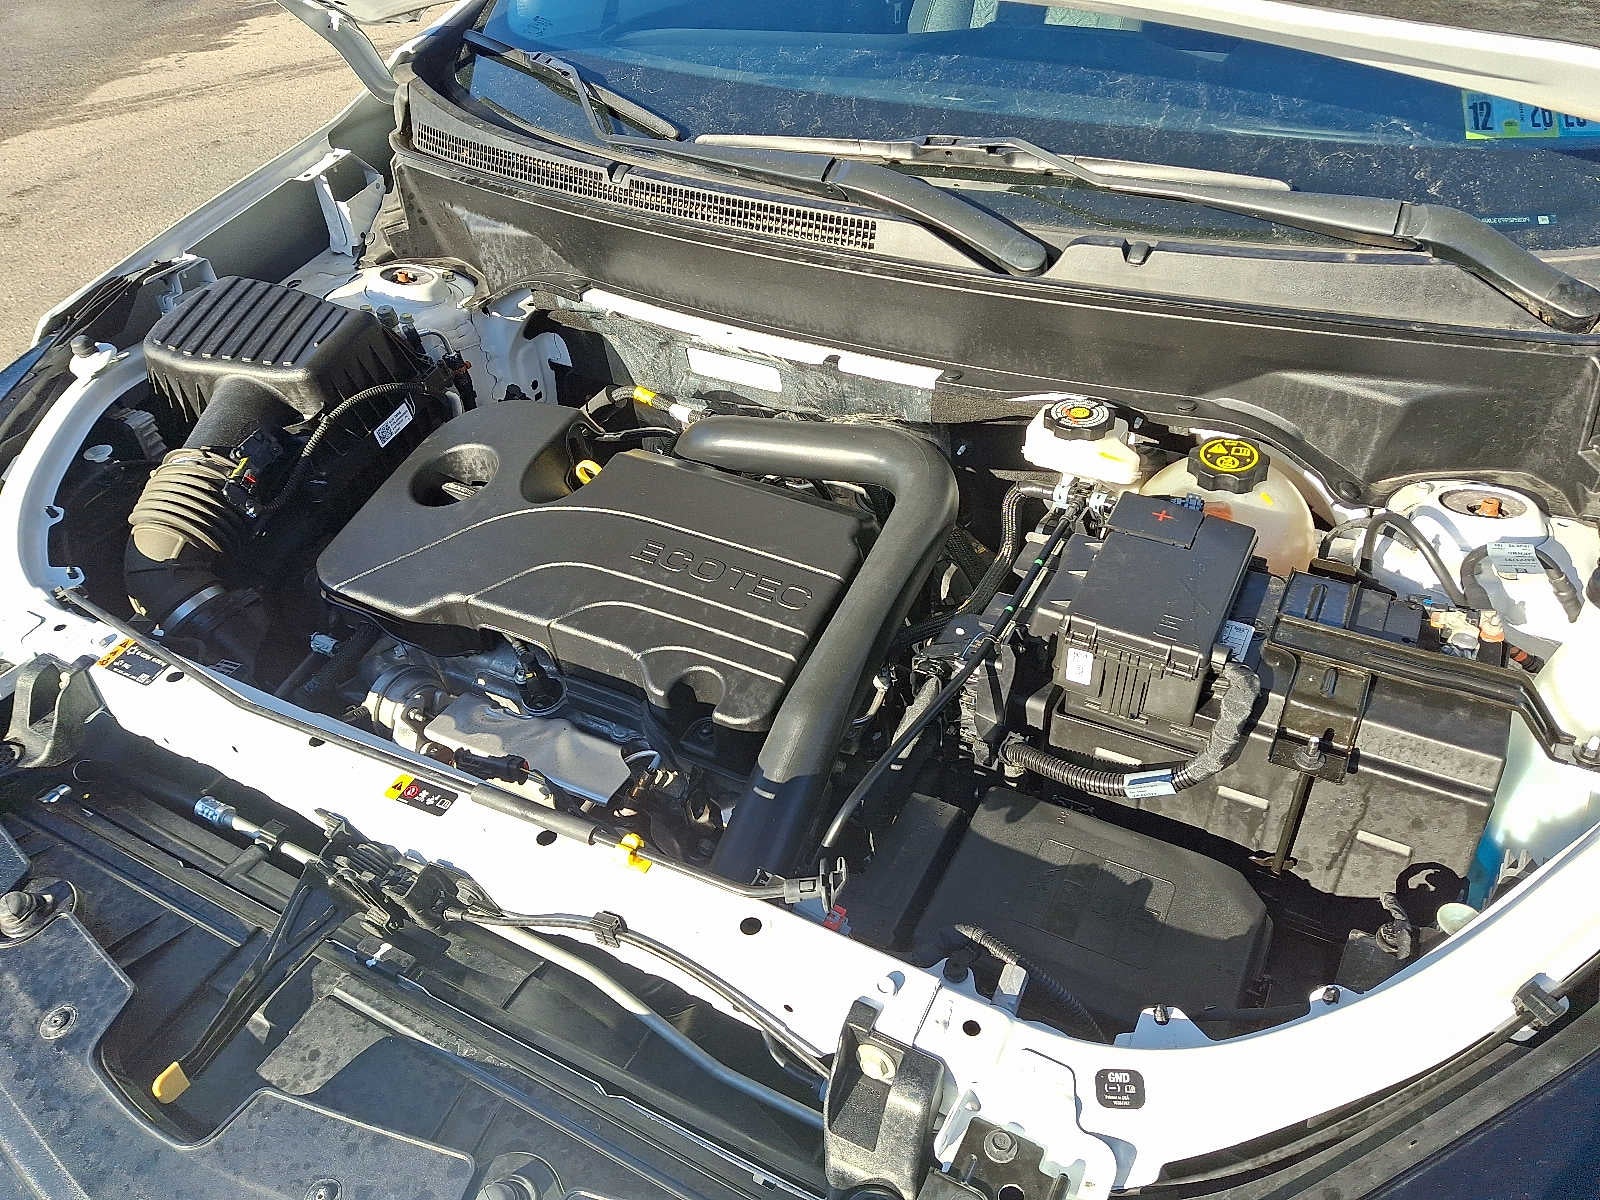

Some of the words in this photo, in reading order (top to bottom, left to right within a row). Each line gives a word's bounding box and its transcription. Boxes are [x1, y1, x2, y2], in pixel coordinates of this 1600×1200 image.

[1468, 101, 1494, 130] 12
[629, 539, 813, 611] ECOTEC
[1107, 1072, 1130, 1083] GND
